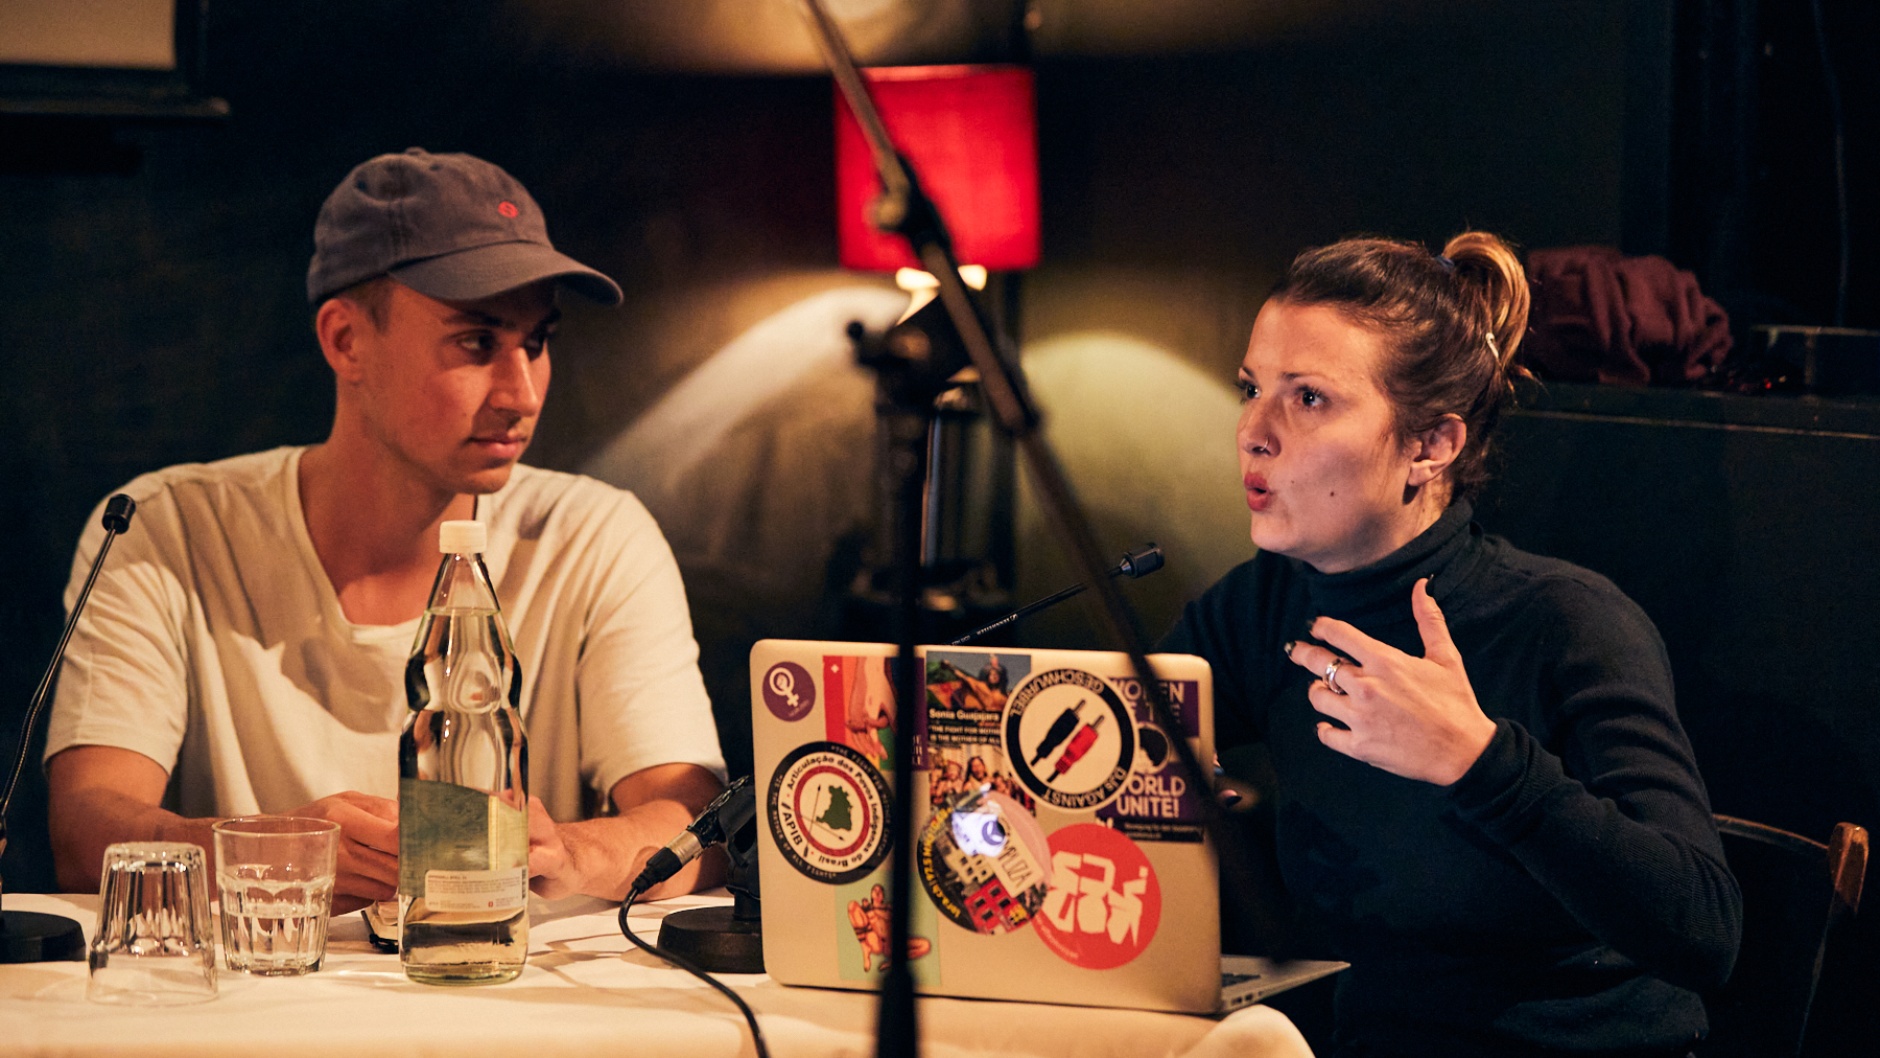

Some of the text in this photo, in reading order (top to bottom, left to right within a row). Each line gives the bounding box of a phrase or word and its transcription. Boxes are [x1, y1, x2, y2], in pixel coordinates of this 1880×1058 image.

[929, 708, 955, 719] Sonia
[938, 734, 950, 742] THE
[786, 754, 835, 791] Articulação
[837, 758, 854, 774] dos
[854, 771, 874, 801] Povos
[1117, 774, 1186, 798] ORLD
[1042, 787, 1105, 808] AGAINST
[1115, 795, 1180, 819] UNITE!
[781, 811, 804, 847] APIB
[818, 854, 849, 868] Brasil
